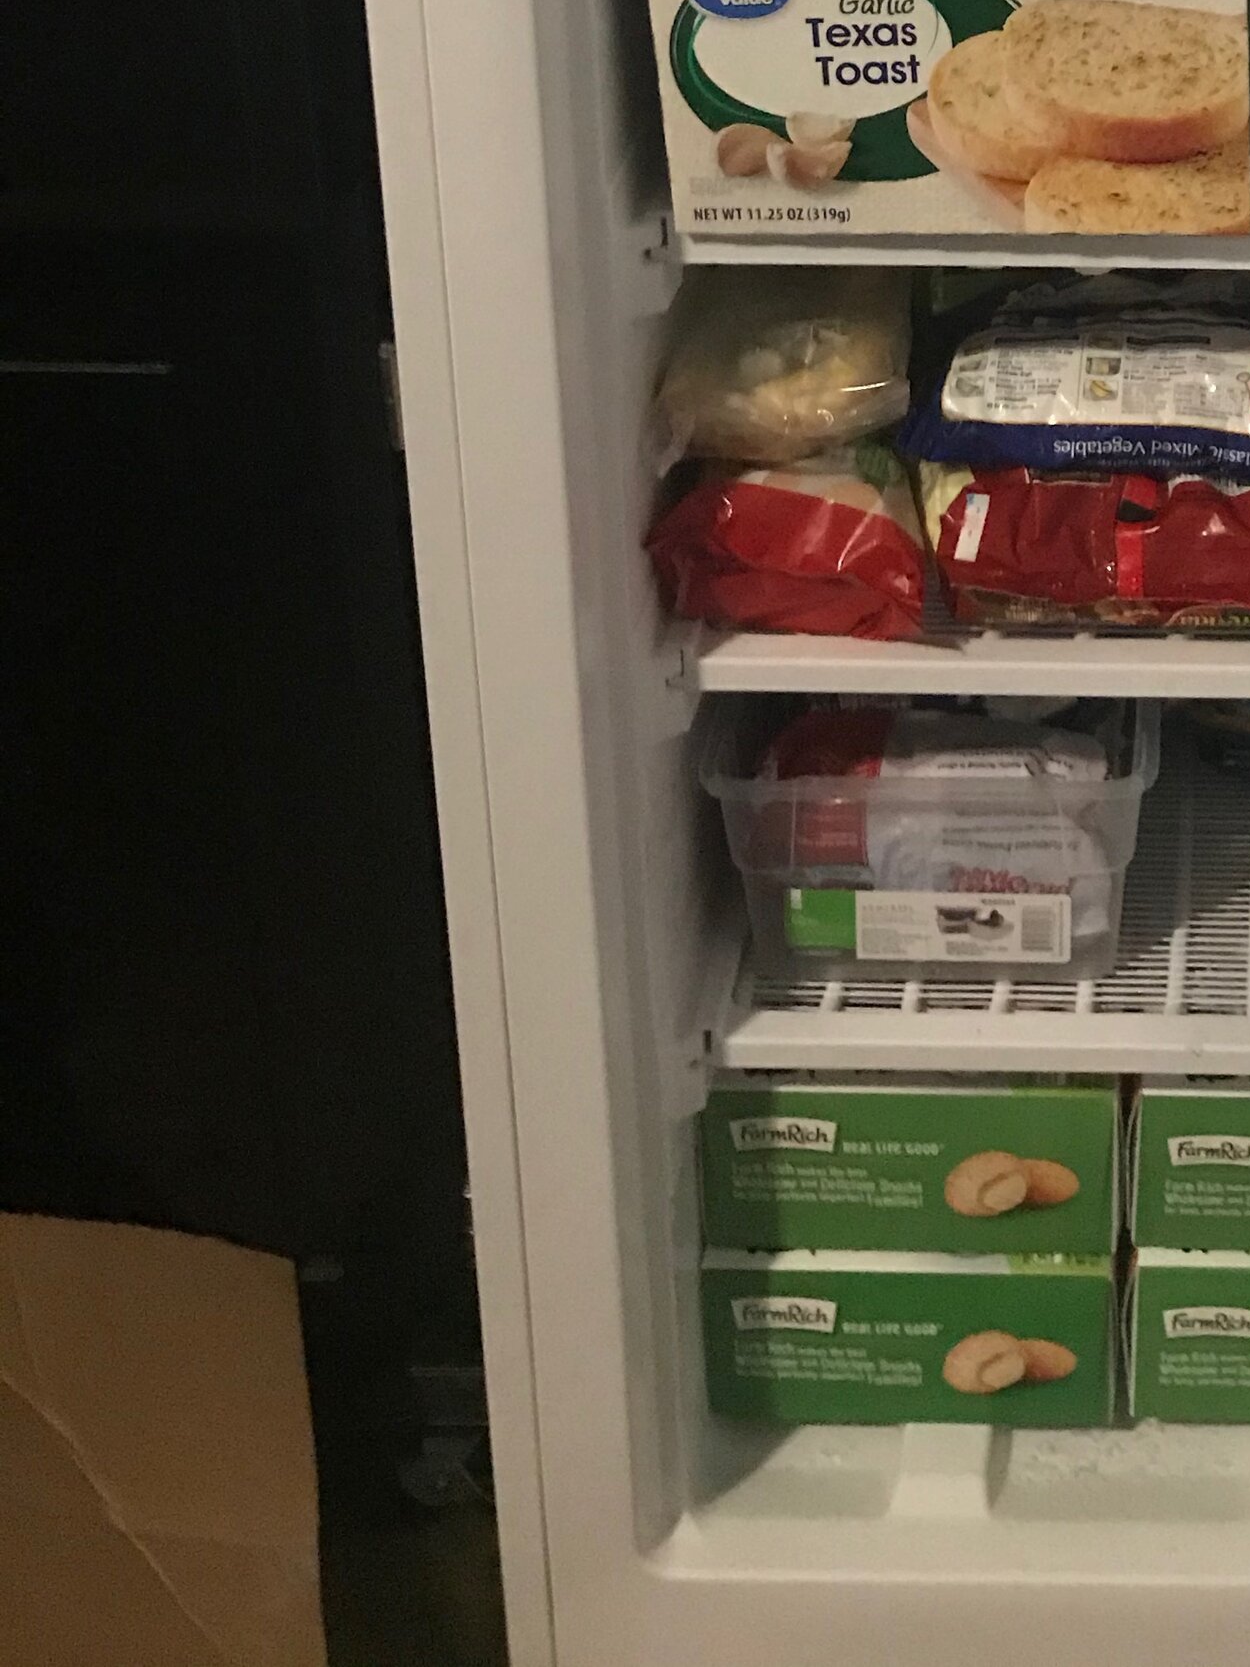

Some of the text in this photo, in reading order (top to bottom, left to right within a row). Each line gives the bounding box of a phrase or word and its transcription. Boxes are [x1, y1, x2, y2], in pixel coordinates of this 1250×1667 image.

[805, 18, 918, 48] Texas
[815, 54, 920, 86] Toast
[693, 207, 851, 223] NET WT 11.25 OZ (319g)
[1053, 437, 1146, 458] Vegetables
